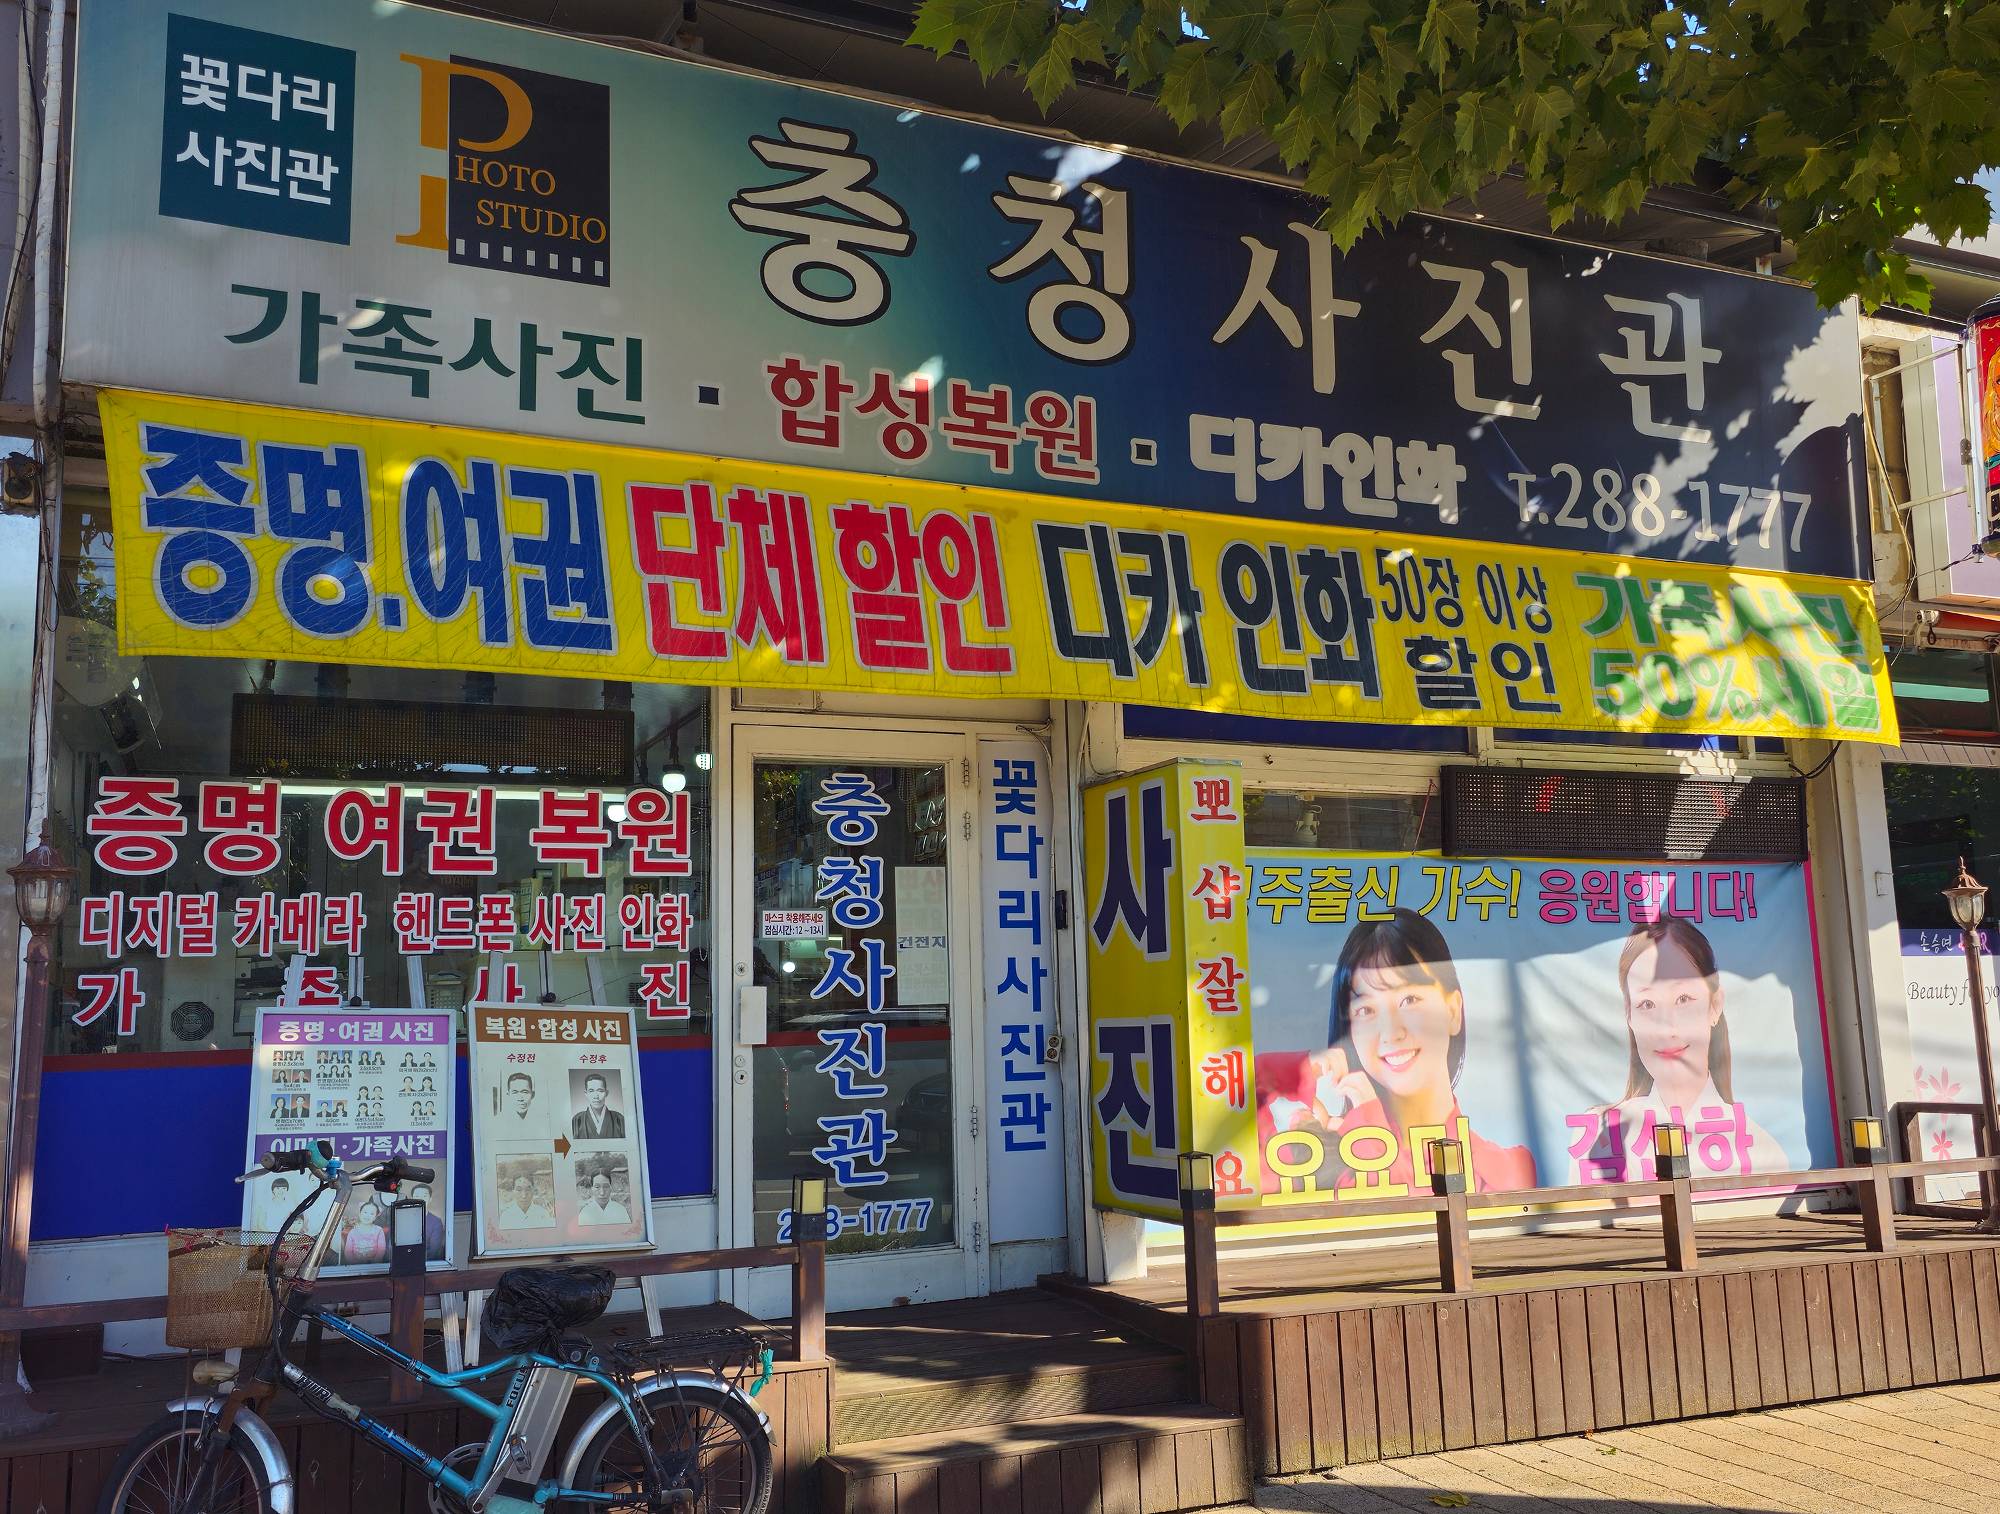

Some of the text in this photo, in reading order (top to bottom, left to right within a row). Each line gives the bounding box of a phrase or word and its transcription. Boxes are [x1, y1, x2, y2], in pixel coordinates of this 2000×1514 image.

[180, 53, 336, 131] 꽃다리
[176, 129, 339, 206] 사진관
[475, 199, 607, 244] STUDIO
[224, 283, 1466, 524] 가족사진 합성복원 디카인화
[1507, 463, 1812, 553] T.288-1777
[1376, 548, 1553, 634] 50장 이상
[1572, 571, 1866, 657] 가족사진
[1403, 635, 1562, 713] 할인
[88, 776, 692, 878] 증명 여권 복원
[78, 891, 694, 959] 디지털 카메라 핸드폰 사진 인화
[765, 913, 823, 923] 마스크 착용해주세요
[1245, 865, 1758, 925] 주출신 가수! 응원합니다!
[810, 772, 898, 1189] 충청사진관
[898, 935, 946, 949] 건전지
[993, 758, 1051, 1153] 꽃다리사진관
[1091, 778, 1180, 1203] 사진
[1907, 981, 1958, 1006] Beauty
[389, 1021, 434, 1042] 사진
[507, 1053, 607, 1064] 수정전 수정후
[582, 1018, 622, 1041] 사진
[777, 1198, 934, 1243] 28-1777
